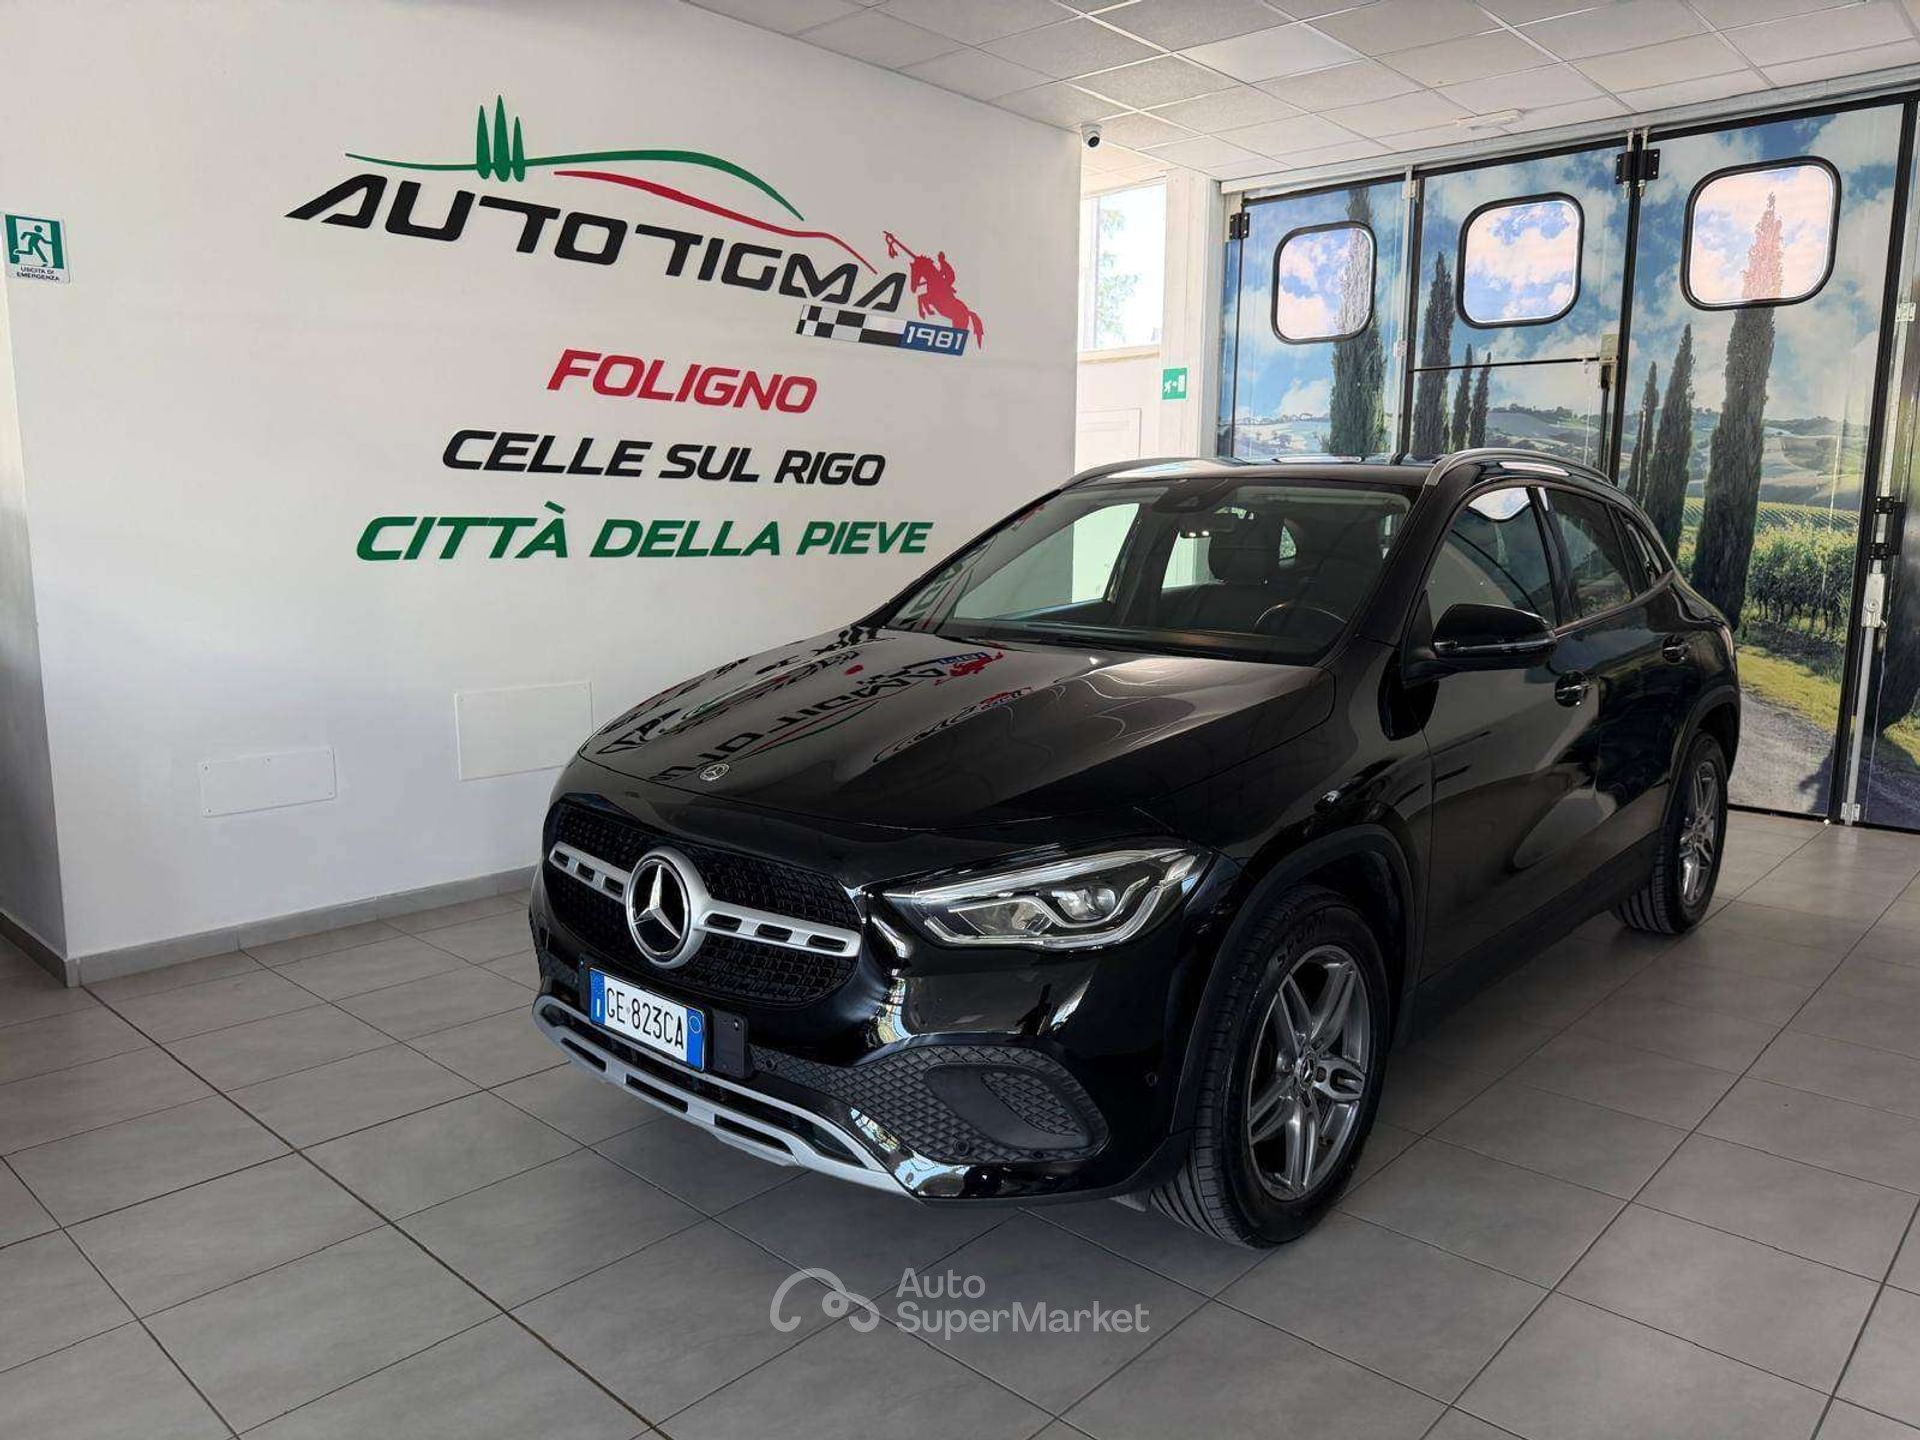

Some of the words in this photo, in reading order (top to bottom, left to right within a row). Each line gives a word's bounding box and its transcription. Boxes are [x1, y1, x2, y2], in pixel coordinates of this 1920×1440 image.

[284, 173, 908, 313] AUTOTIGMA
[16, 271, 60, 280] EMERGENZA
[906, 325, 963, 350] 1981
[547, 348, 818, 414] FOLIGNO
[442, 429, 655, 479] CELLE
[657, 442, 761, 484] SUL
[773, 449, 887, 488] RIGO
[356, 501, 569, 562] CITTÀ
[590, 519, 780, 558] DELLA
[797, 521, 933, 555] PIEVE
[631, 997, 684, 1049] 823CA
